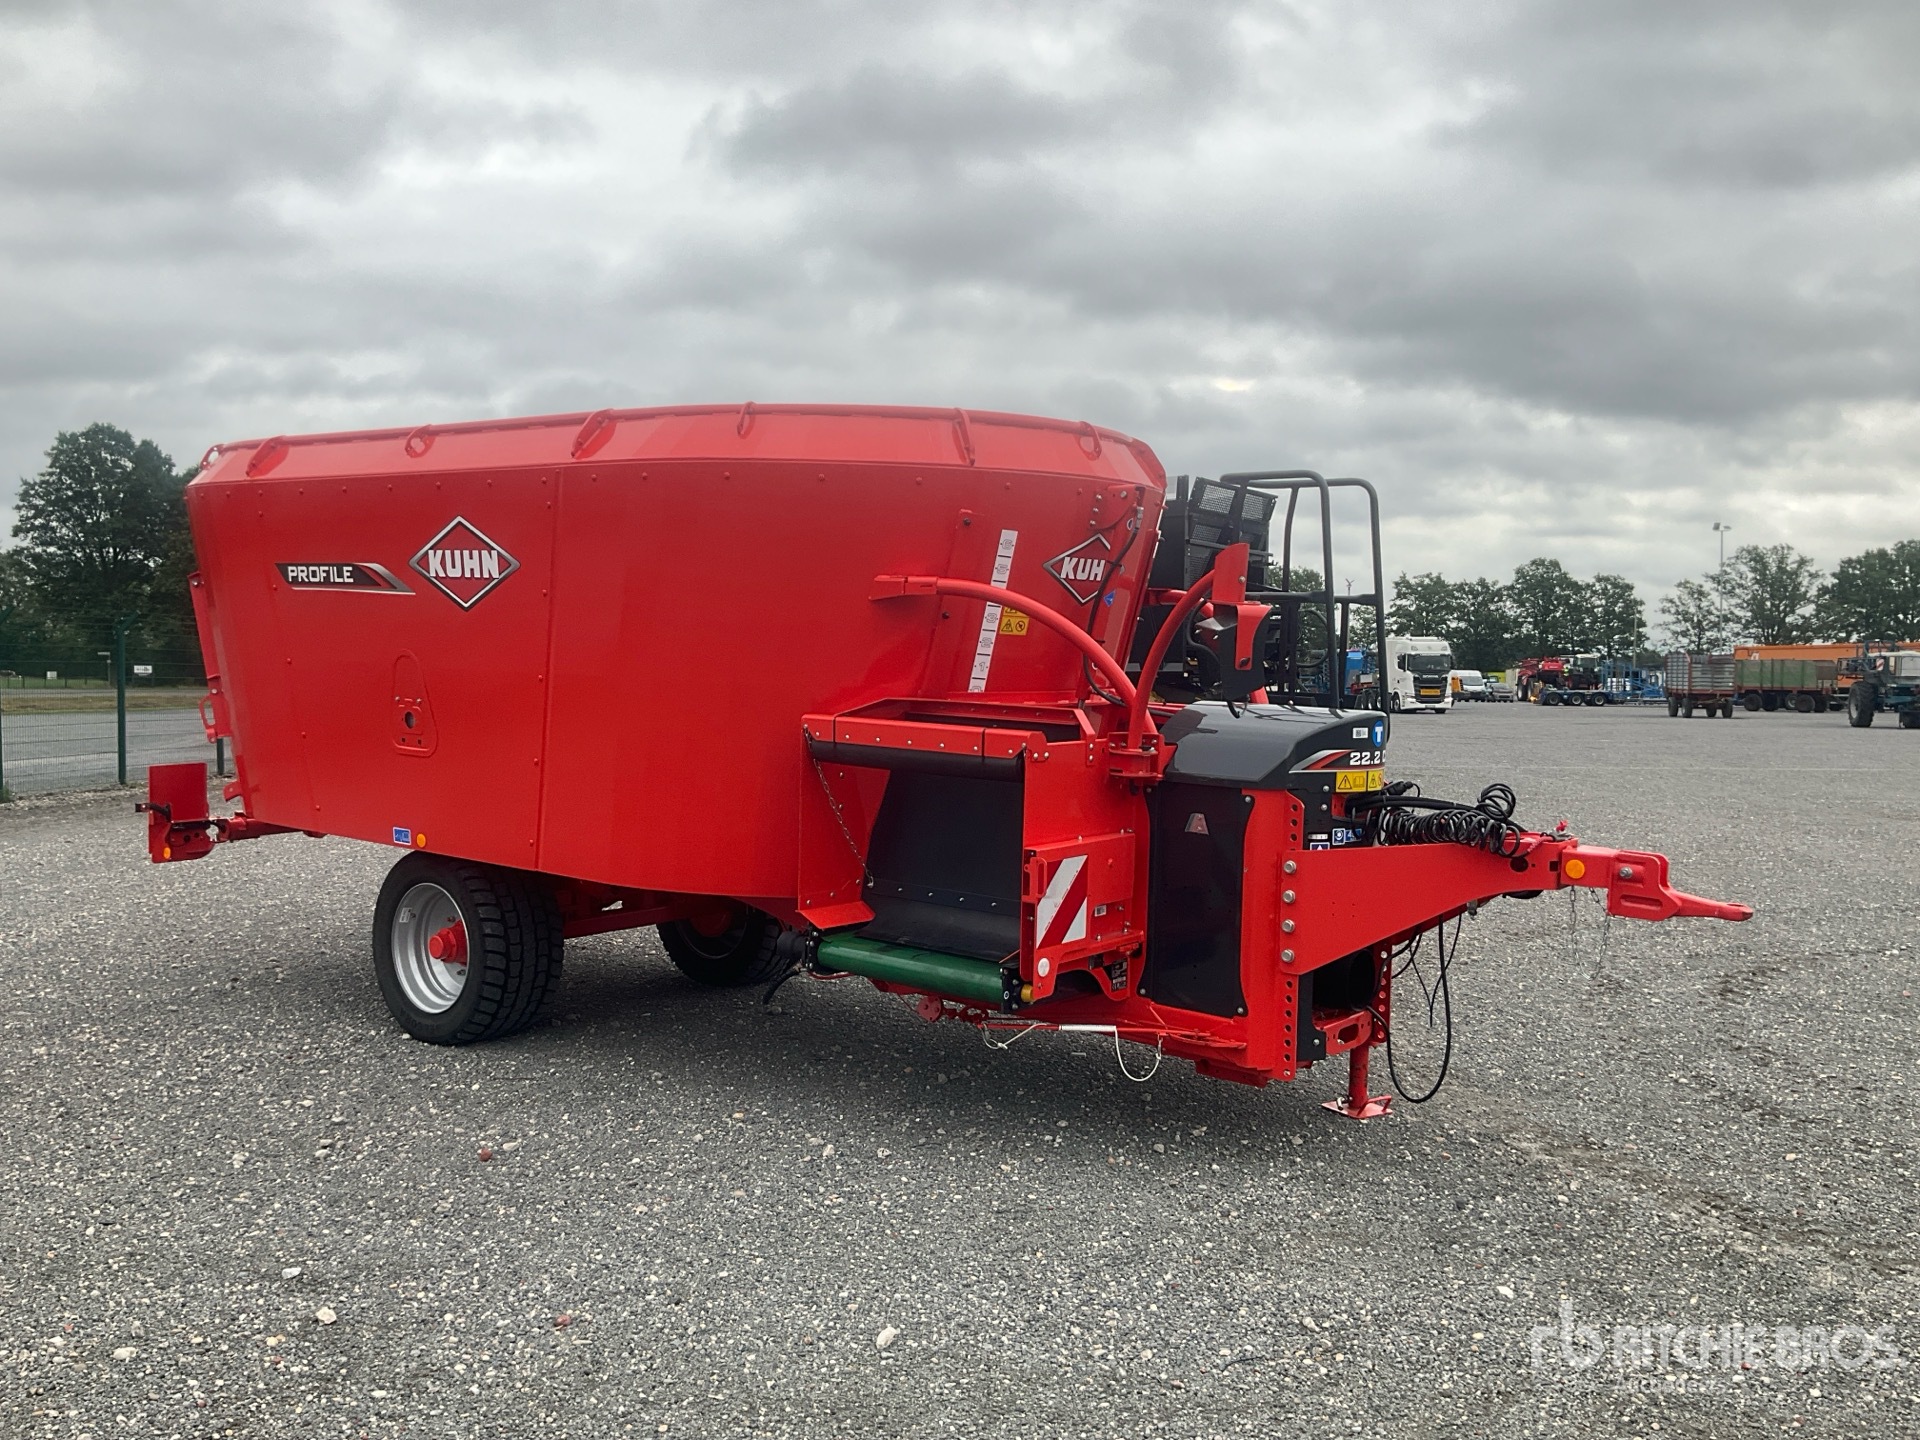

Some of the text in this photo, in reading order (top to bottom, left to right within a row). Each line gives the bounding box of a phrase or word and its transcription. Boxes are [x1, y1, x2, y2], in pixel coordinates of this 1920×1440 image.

[428, 549, 500, 579] KUHN
[1060, 556, 1106, 581] KUH
[287, 566, 354, 583] PROFILE
[1374, 725, 1384, 743] T
[1349, 750, 1381, 766] 22.2
